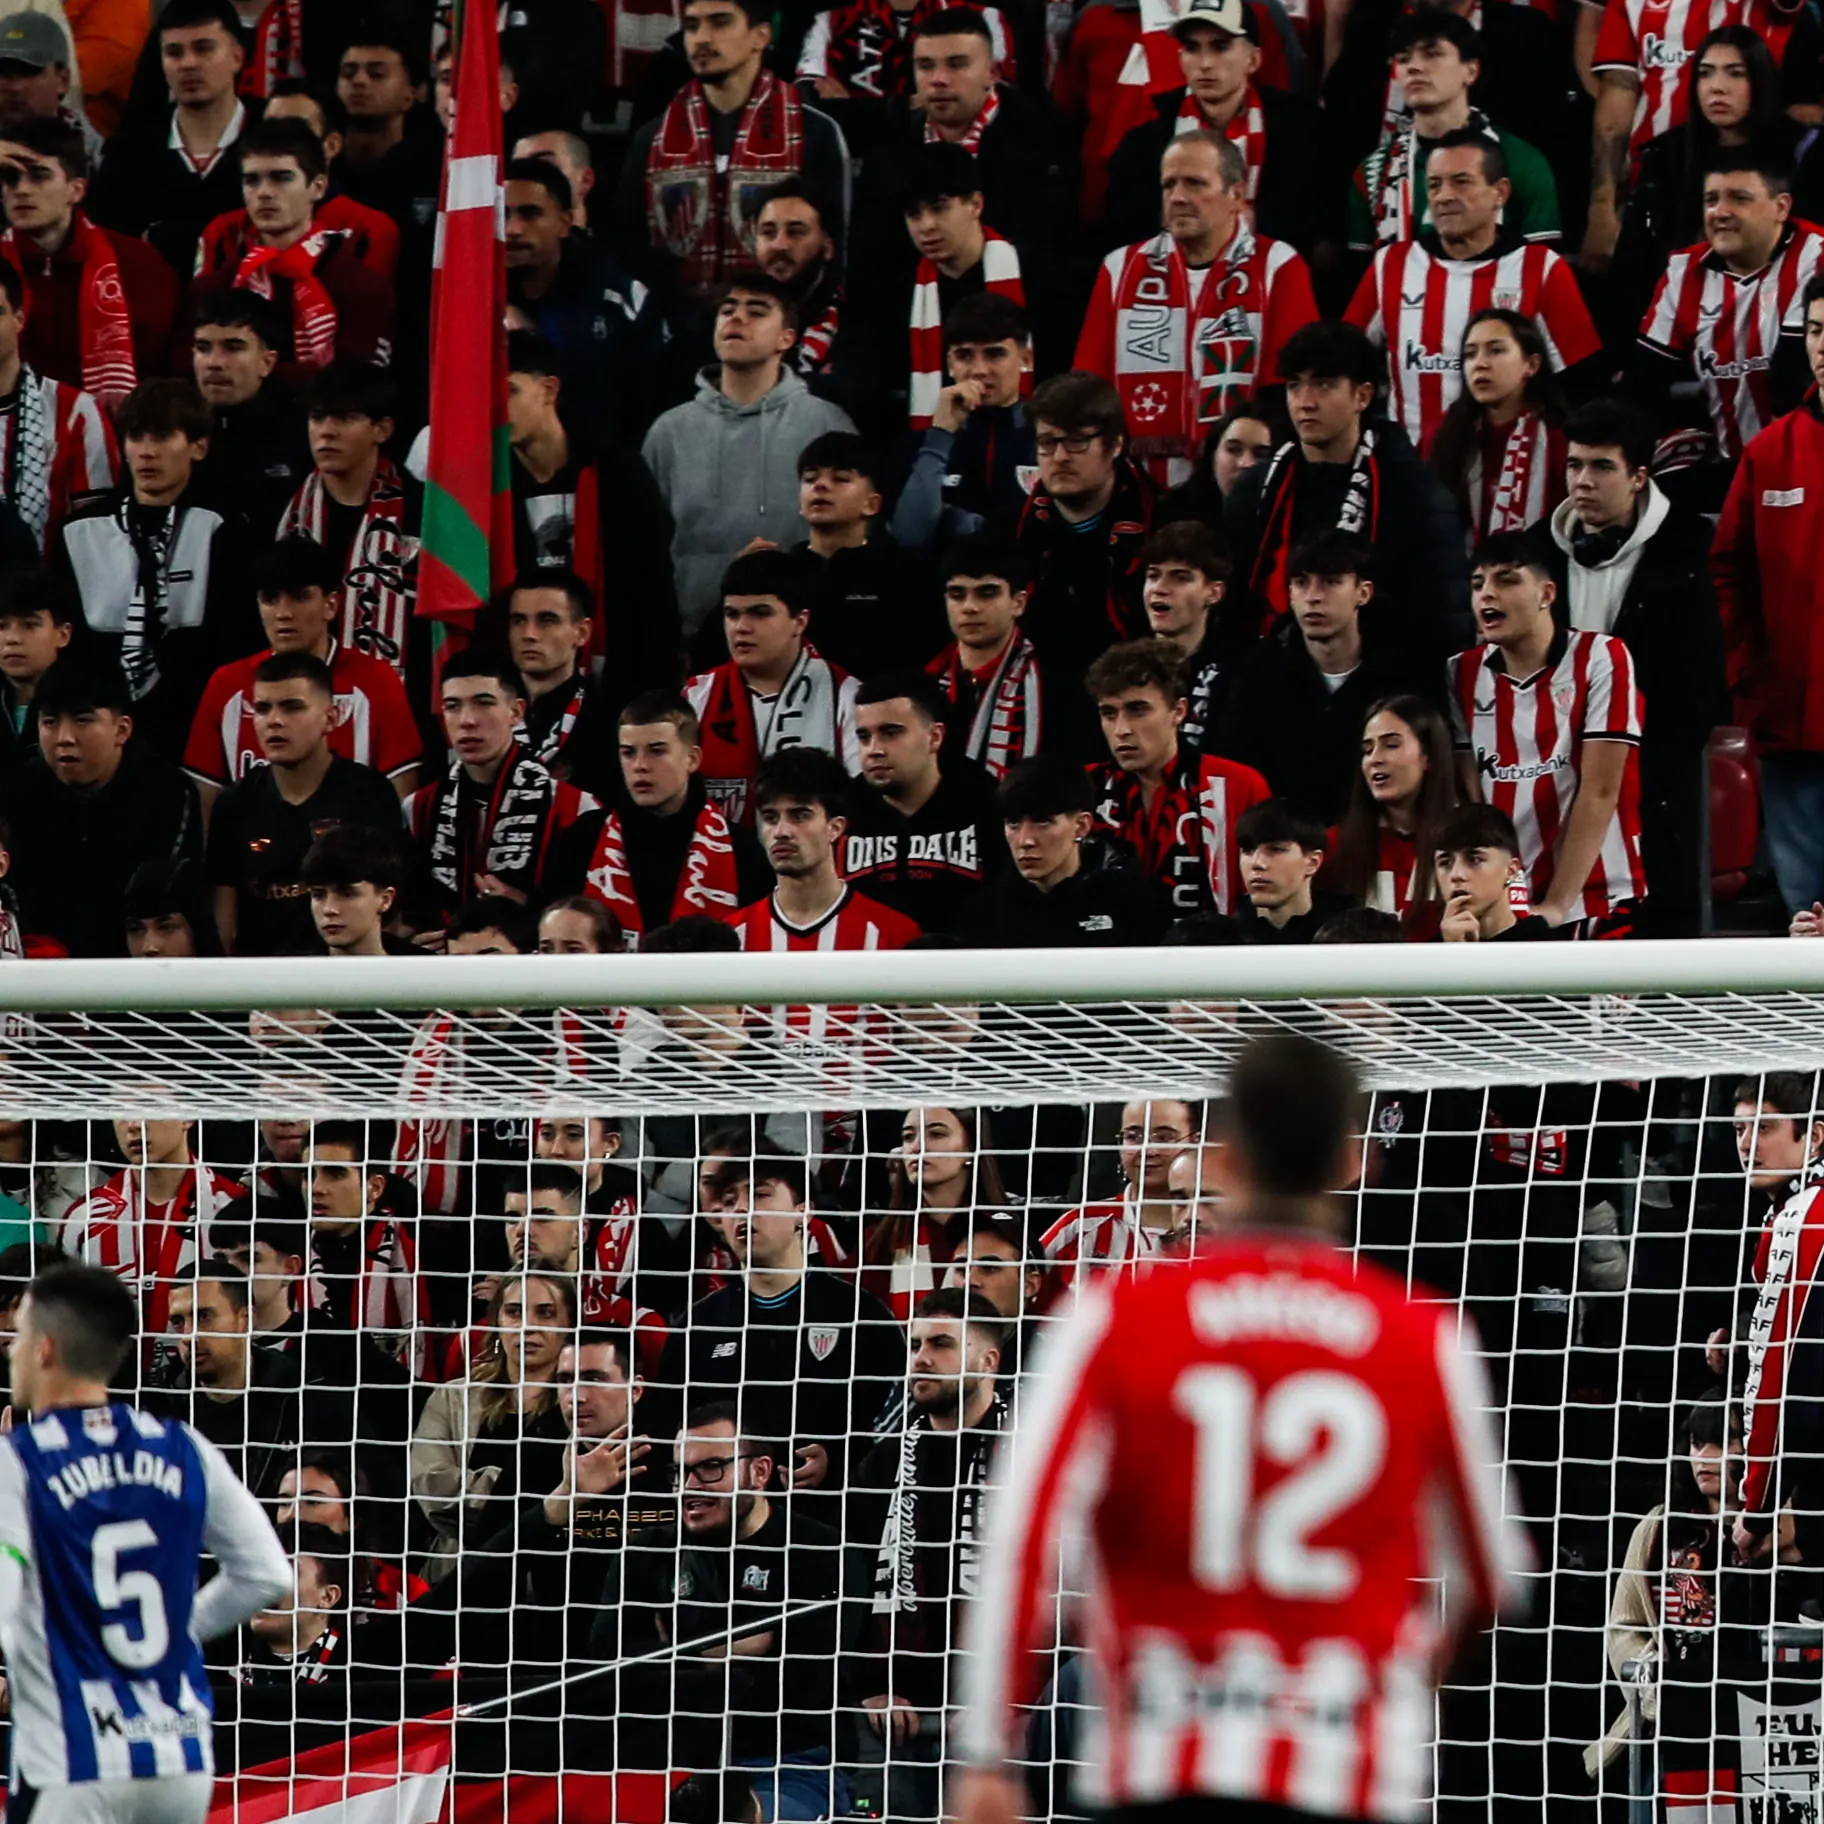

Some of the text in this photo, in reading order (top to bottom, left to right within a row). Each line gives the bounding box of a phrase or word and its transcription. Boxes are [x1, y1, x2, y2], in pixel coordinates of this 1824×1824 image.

[1405, 340, 1462, 374] Kutxa
[491, 758, 547, 873] CLUB
[845, 830, 982, 875] ONSDALE
[1173, 812, 1200, 910] CLU
[47, 1450, 184, 1511] ZUBELDIA
[1170, 1361, 1392, 1594] 12
[91, 1519, 170, 1672] 5
